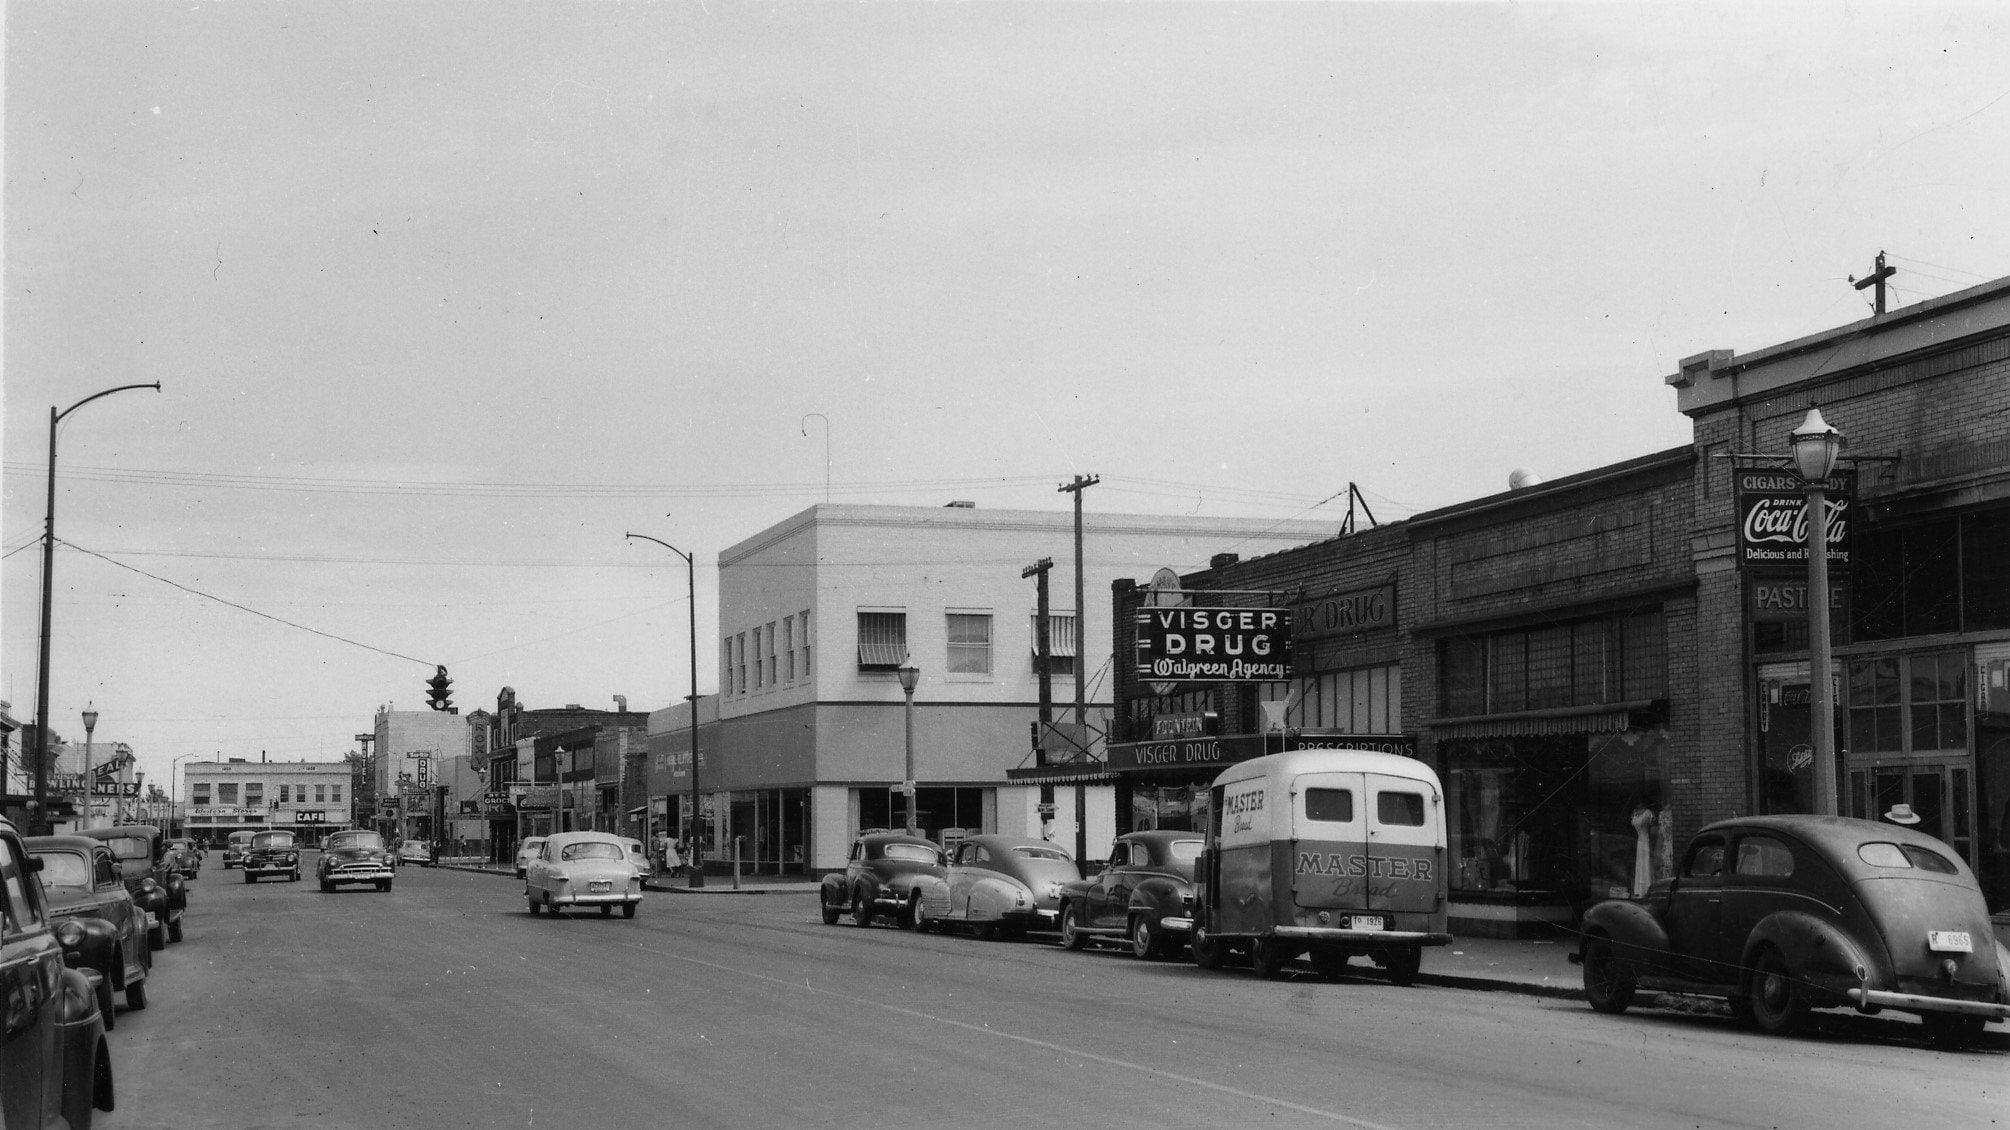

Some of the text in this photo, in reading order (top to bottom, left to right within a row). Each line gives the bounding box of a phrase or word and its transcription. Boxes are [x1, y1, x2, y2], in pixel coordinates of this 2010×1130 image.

[1744, 498, 1849, 544] Coca-Cla
[1746, 547, 1849, 562] Delicious and Rshing
[1757, 586, 1843, 609] PASTE
[1158, 610, 1278, 630] VISGER
[1325, 592, 1385, 630] DRUG
[1164, 633, 1272, 656] DRUG
[1153, 657, 1285, 679] Walgreen Agency
[475, 724, 483, 765] ROXY
[1135, 741, 1220, 765] VISGER DRUG
[97, 760, 120, 776] EAL
[29, 779, 87, 789] BWLIN
[1226, 790, 1264, 816] MASTER
[296, 813, 325, 822] CAFE
[1296, 852, 1432, 881] MASTER
[1331, 878, 1398, 899] Bread
